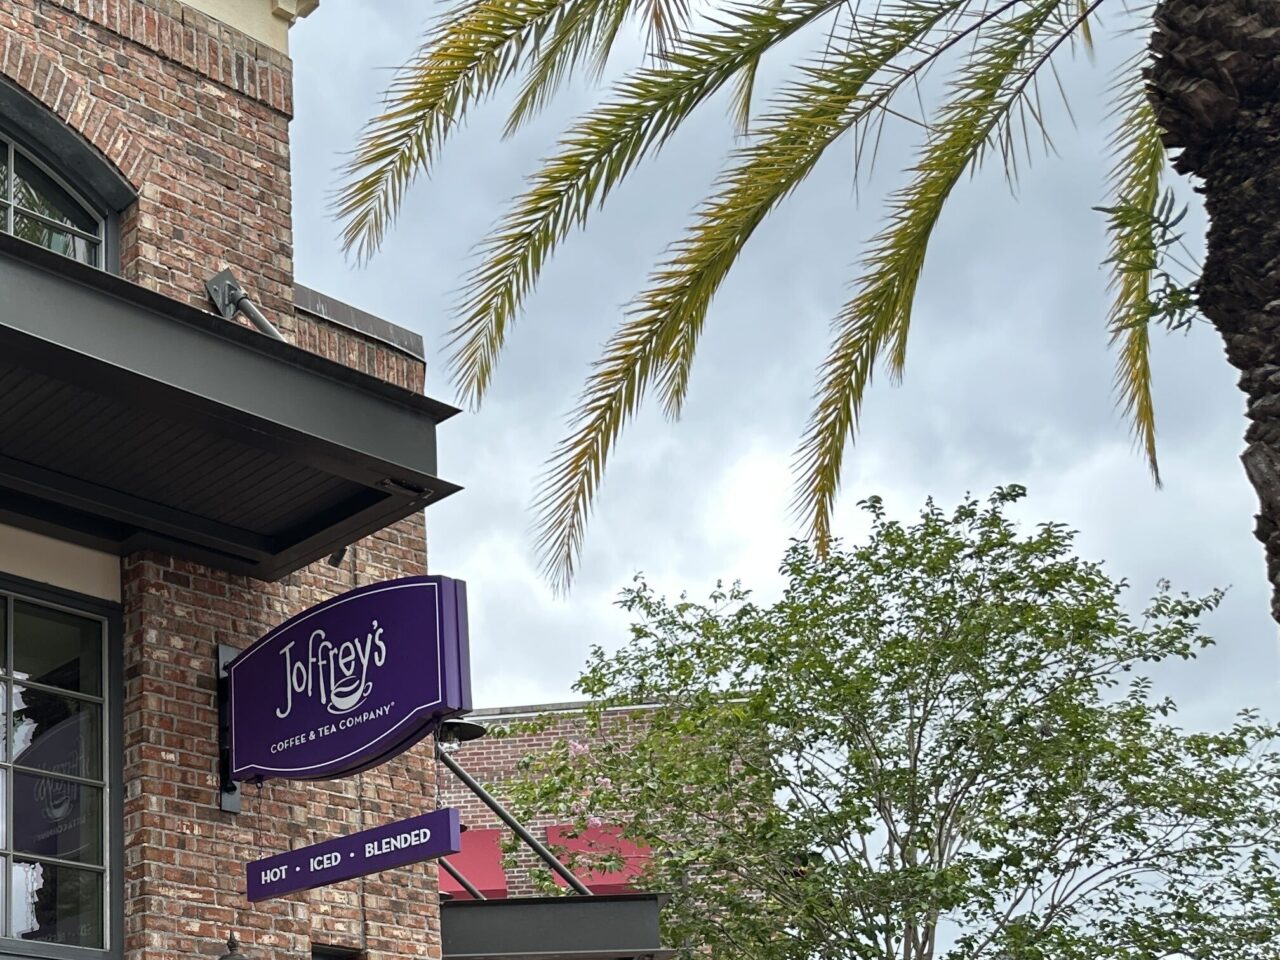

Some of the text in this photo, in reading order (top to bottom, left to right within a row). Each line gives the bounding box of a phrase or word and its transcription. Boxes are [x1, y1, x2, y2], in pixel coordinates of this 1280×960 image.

[276, 619, 387, 719] Joffrey's
[270, 731, 307, 754] COFFEE
[308, 729, 316, 741] &
[318, 724, 337, 739] TEA
[261, 828, 431, 885] HOT ICED BLENDED
